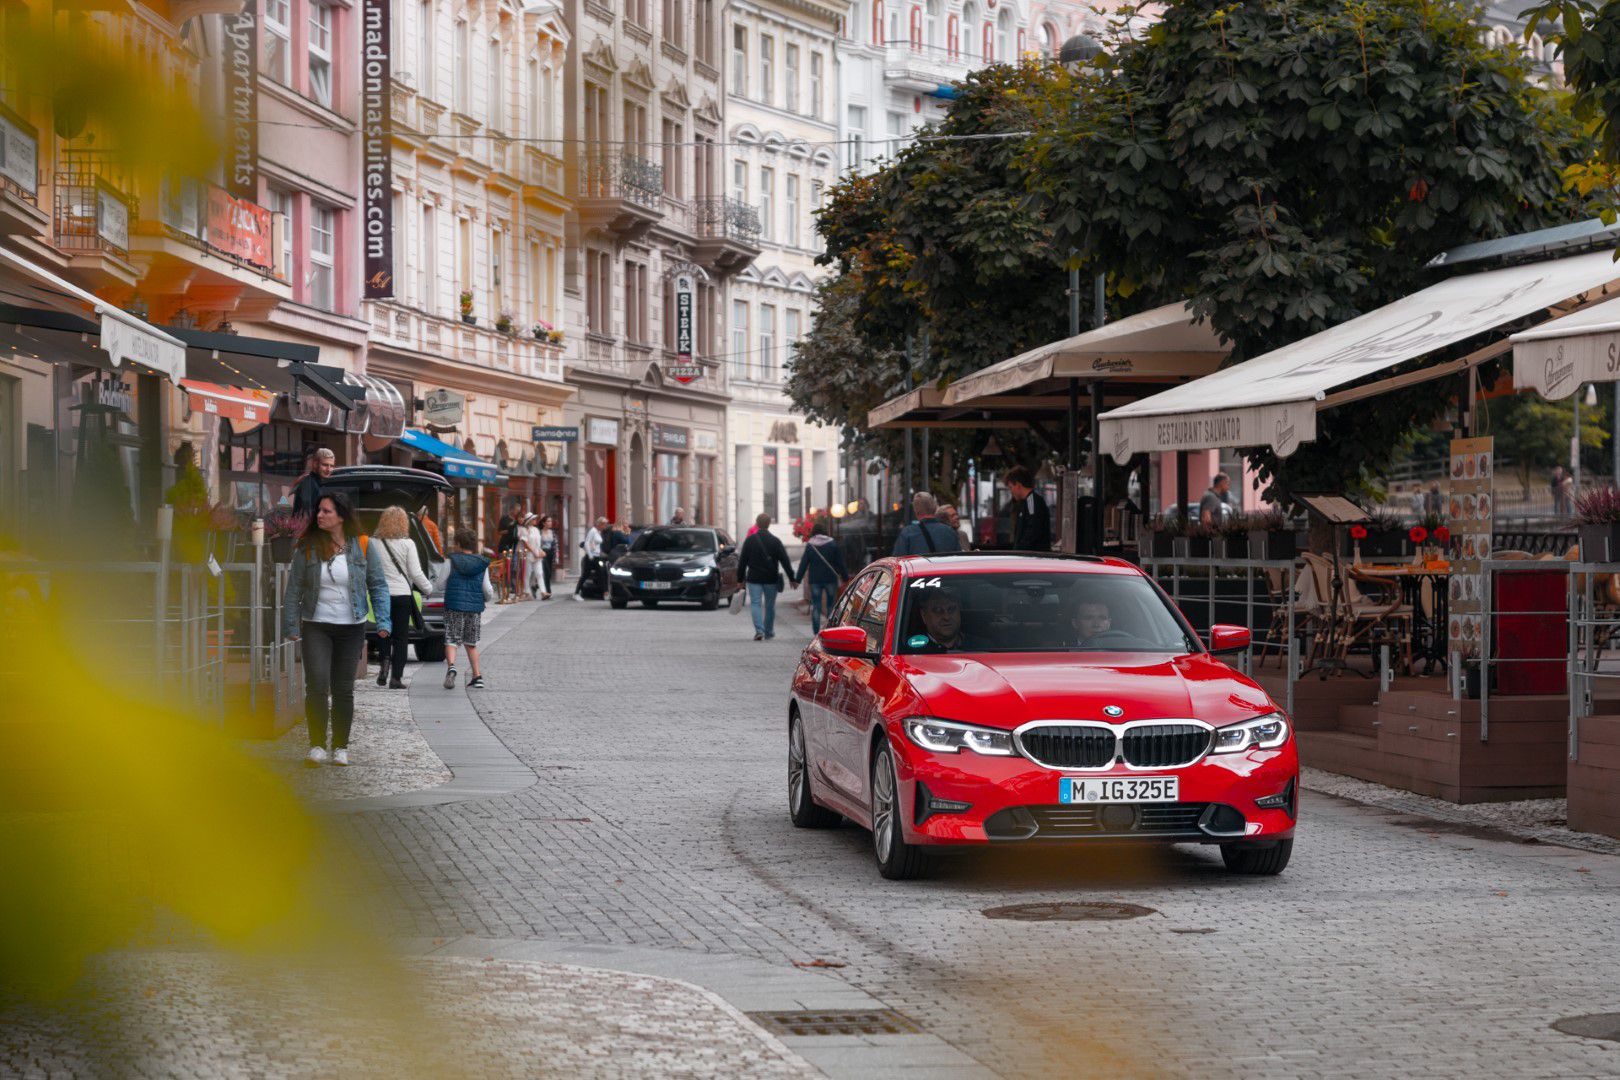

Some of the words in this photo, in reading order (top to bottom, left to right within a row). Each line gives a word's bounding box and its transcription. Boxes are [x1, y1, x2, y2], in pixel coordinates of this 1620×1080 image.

[224, 12, 255, 186] Apartments
[679, 294, 690, 352] STEAK
[669, 367, 701, 377] PIZZA
[1157, 421, 1202, 445] RESTAURANT
[1204, 417, 1241, 442] SALVATOR
[910, 577, 941, 589] 44
[1072, 781, 1085, 800] M
